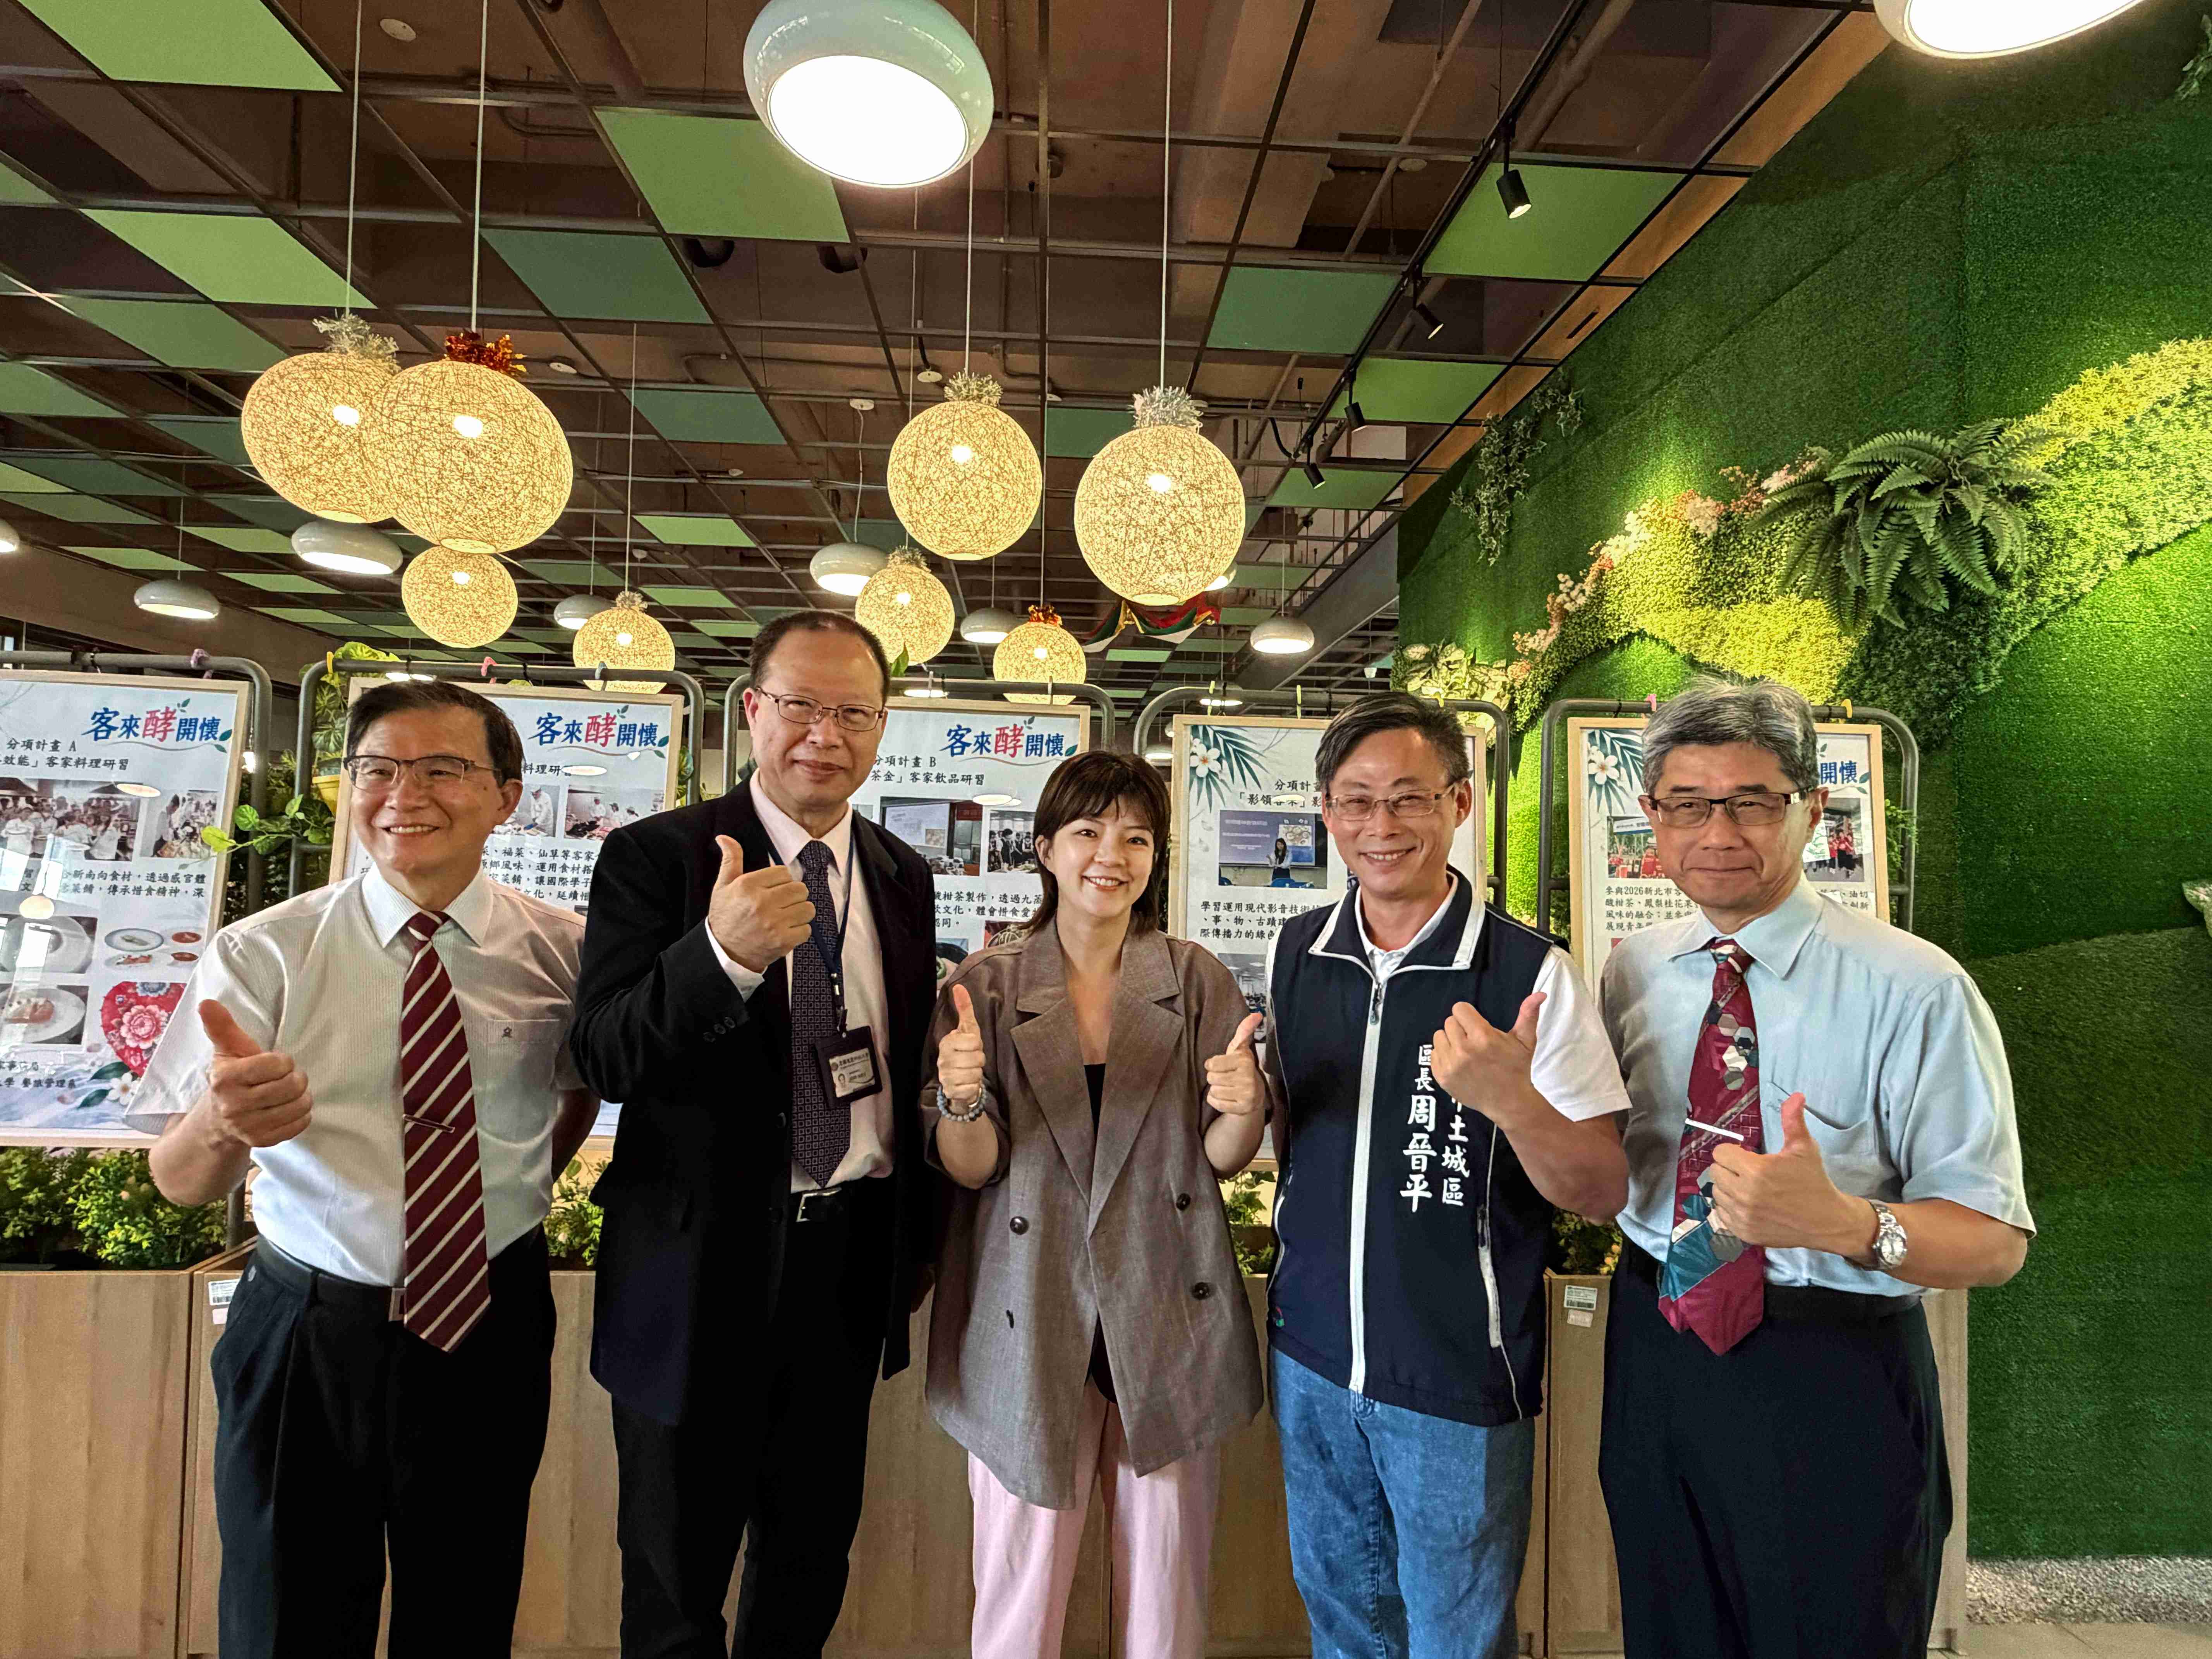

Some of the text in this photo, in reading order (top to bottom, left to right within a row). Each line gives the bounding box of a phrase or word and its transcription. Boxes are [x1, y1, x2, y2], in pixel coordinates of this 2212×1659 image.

[81, 706, 222, 742] 客來酵開懷
[528, 712, 658, 747] 客來酵開懷
[7, 737, 77, 752] 分項計畫 A
[939, 724, 1065, 758] 客來酵開懷
[0, 754, 129, 770] 效能」客家料理研習
[522, 762, 572, 776] 料理研
[929, 756, 936, 767] B
[1820, 760, 1858, 785] 開懷
[1605, 898, 1698, 908] 酸柑茶、鳳梨桂花果
[1441, 1097, 1470, 1206] 土城區
